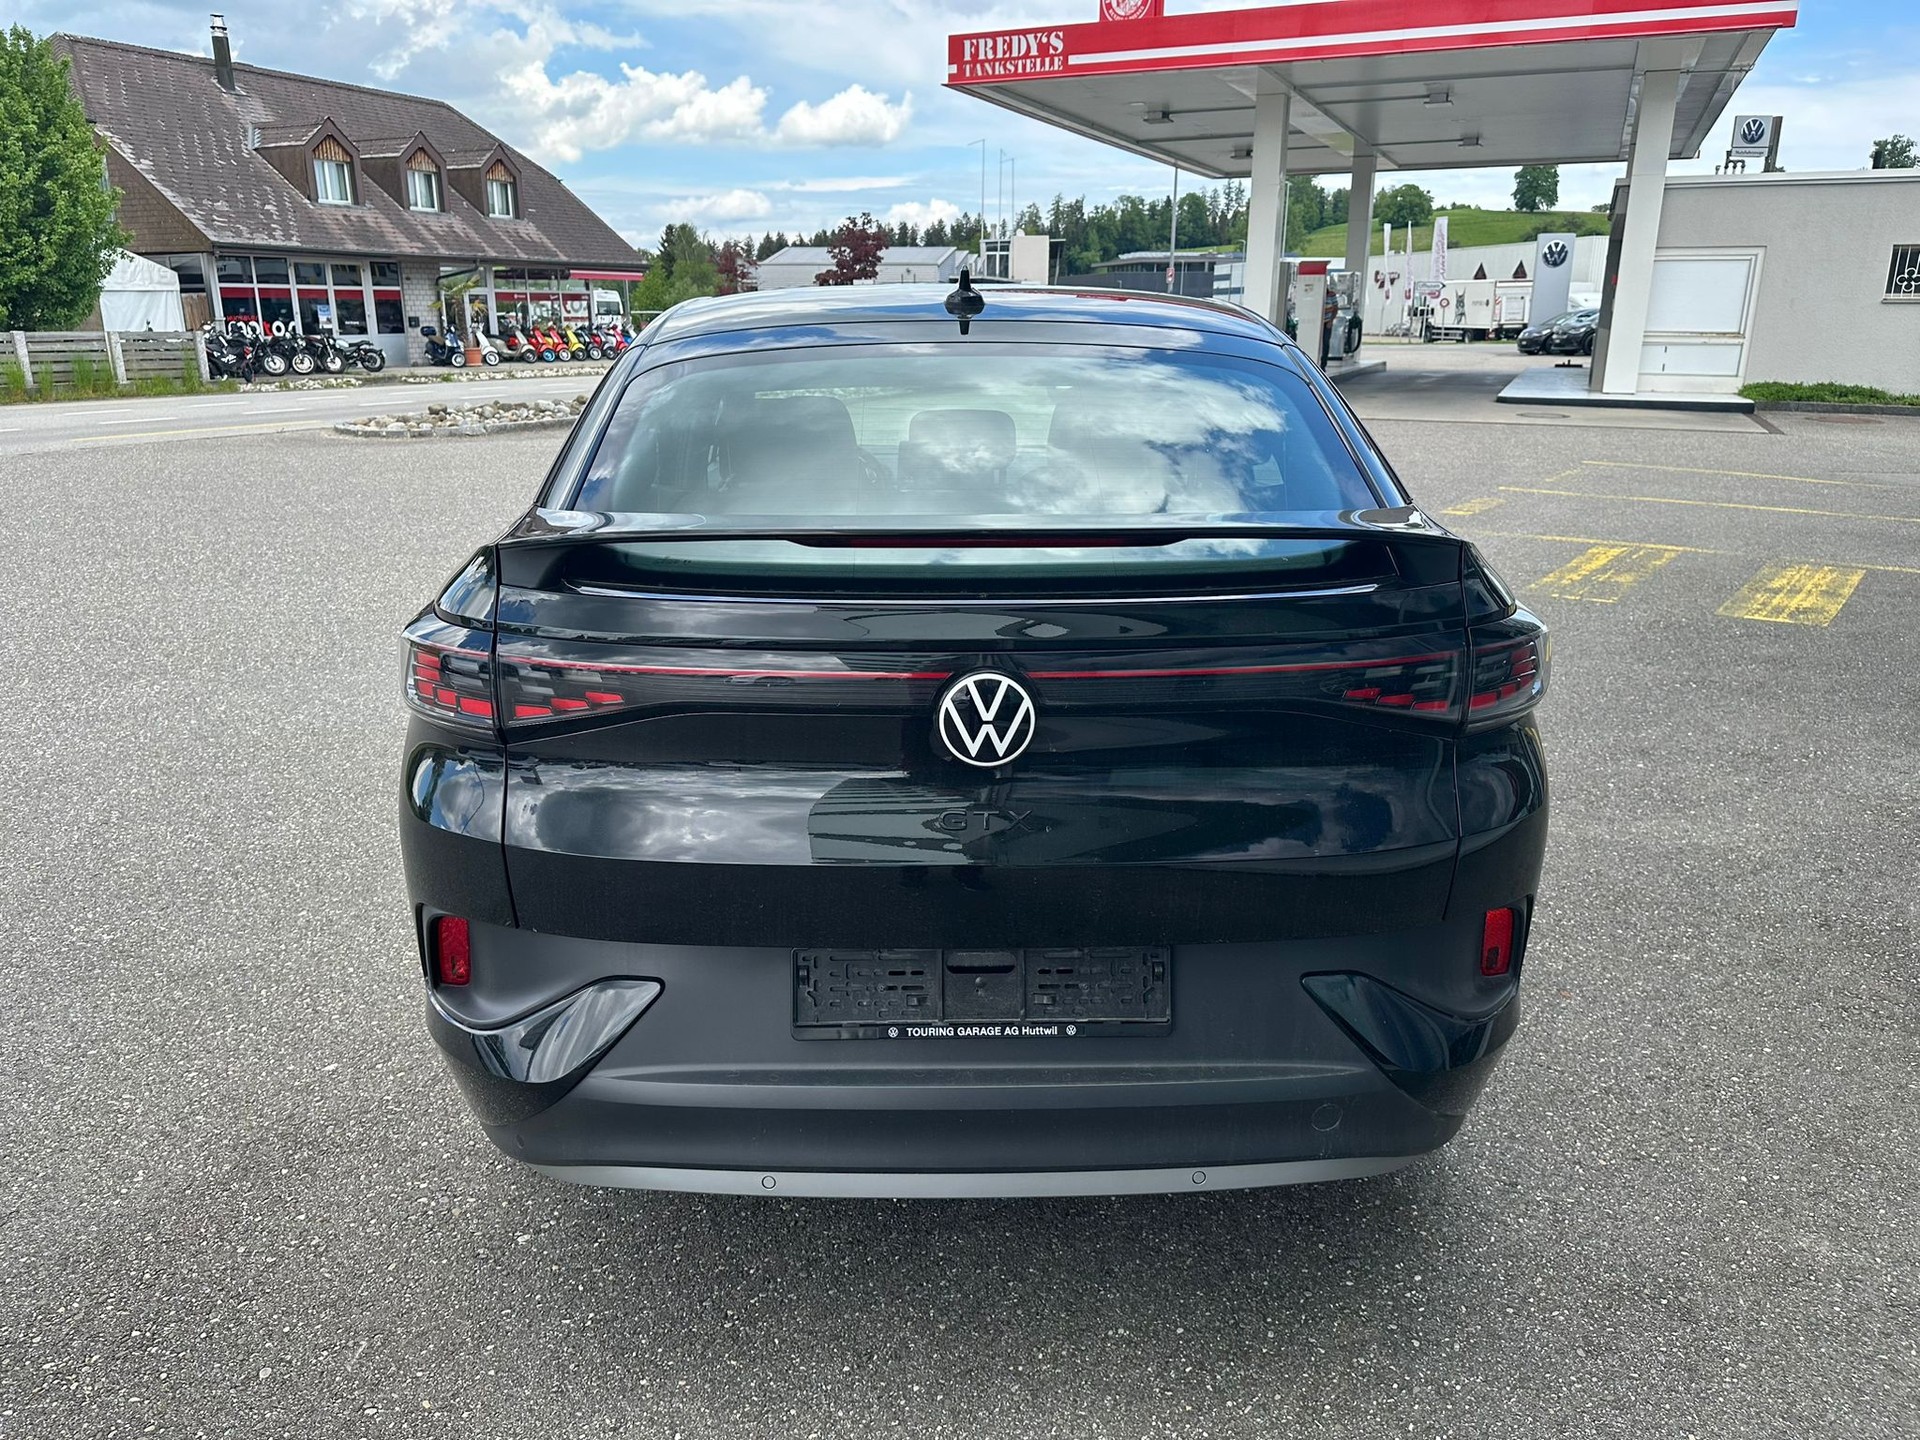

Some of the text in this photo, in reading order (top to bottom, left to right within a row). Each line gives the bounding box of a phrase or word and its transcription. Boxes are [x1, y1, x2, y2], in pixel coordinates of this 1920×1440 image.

[963, 56, 1063, 77] TANKSTELLE
[938, 810, 1034, 832] GTX
[906, 1027, 954, 1037] TOURING
[957, 1027, 1001, 1036] GARAGE
[1004, 1026, 1019, 1036] AG
[1022, 1025, 1058, 1035] Huttwil
